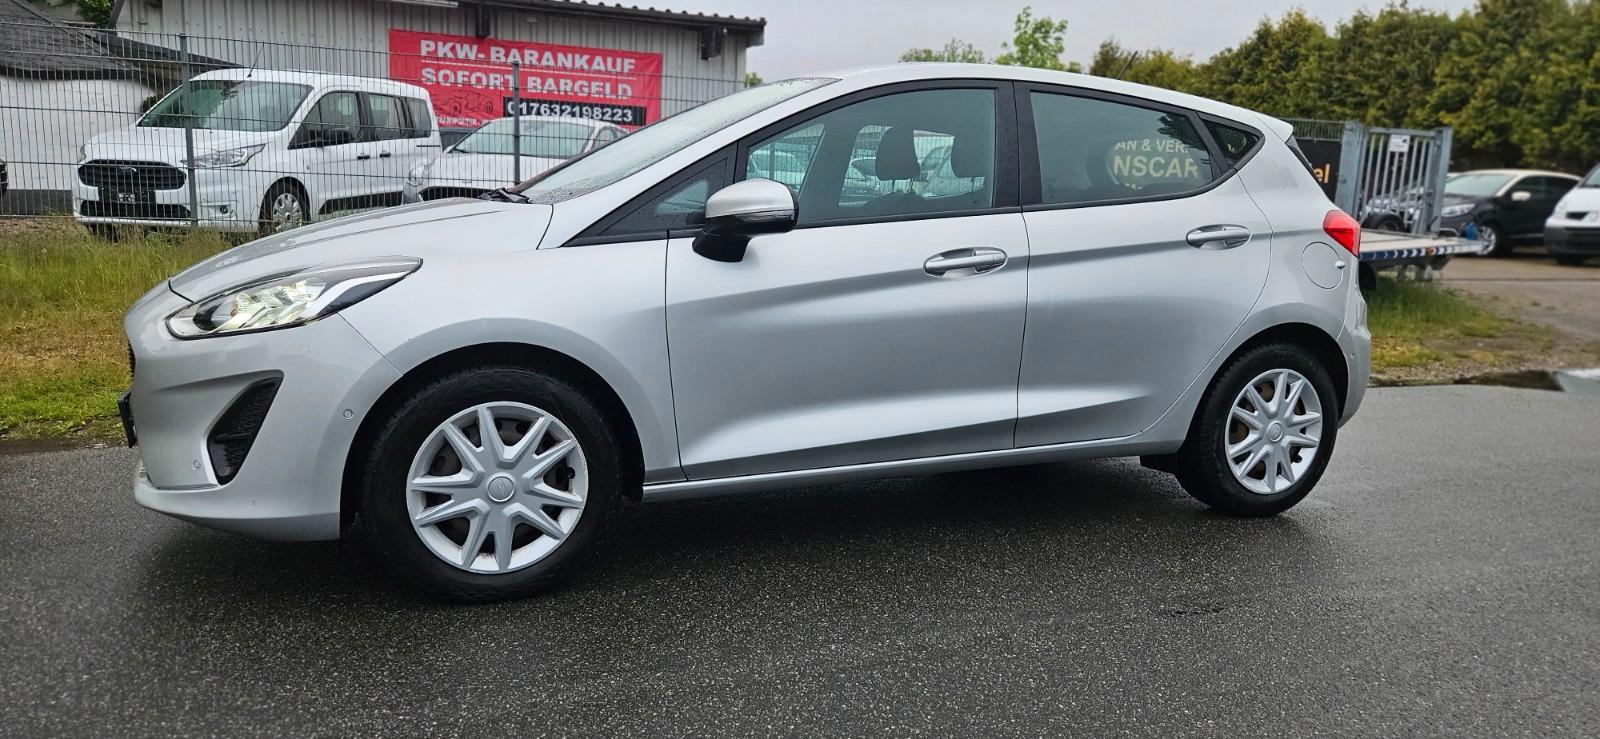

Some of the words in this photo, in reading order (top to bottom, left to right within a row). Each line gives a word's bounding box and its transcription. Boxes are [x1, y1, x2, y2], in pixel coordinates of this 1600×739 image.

[421, 67, 517, 91] SOFORT
[527, 76, 632, 99] BARGELD
[507, 101, 633, 122] 017632198223
[1156, 138, 1189, 154] VER
